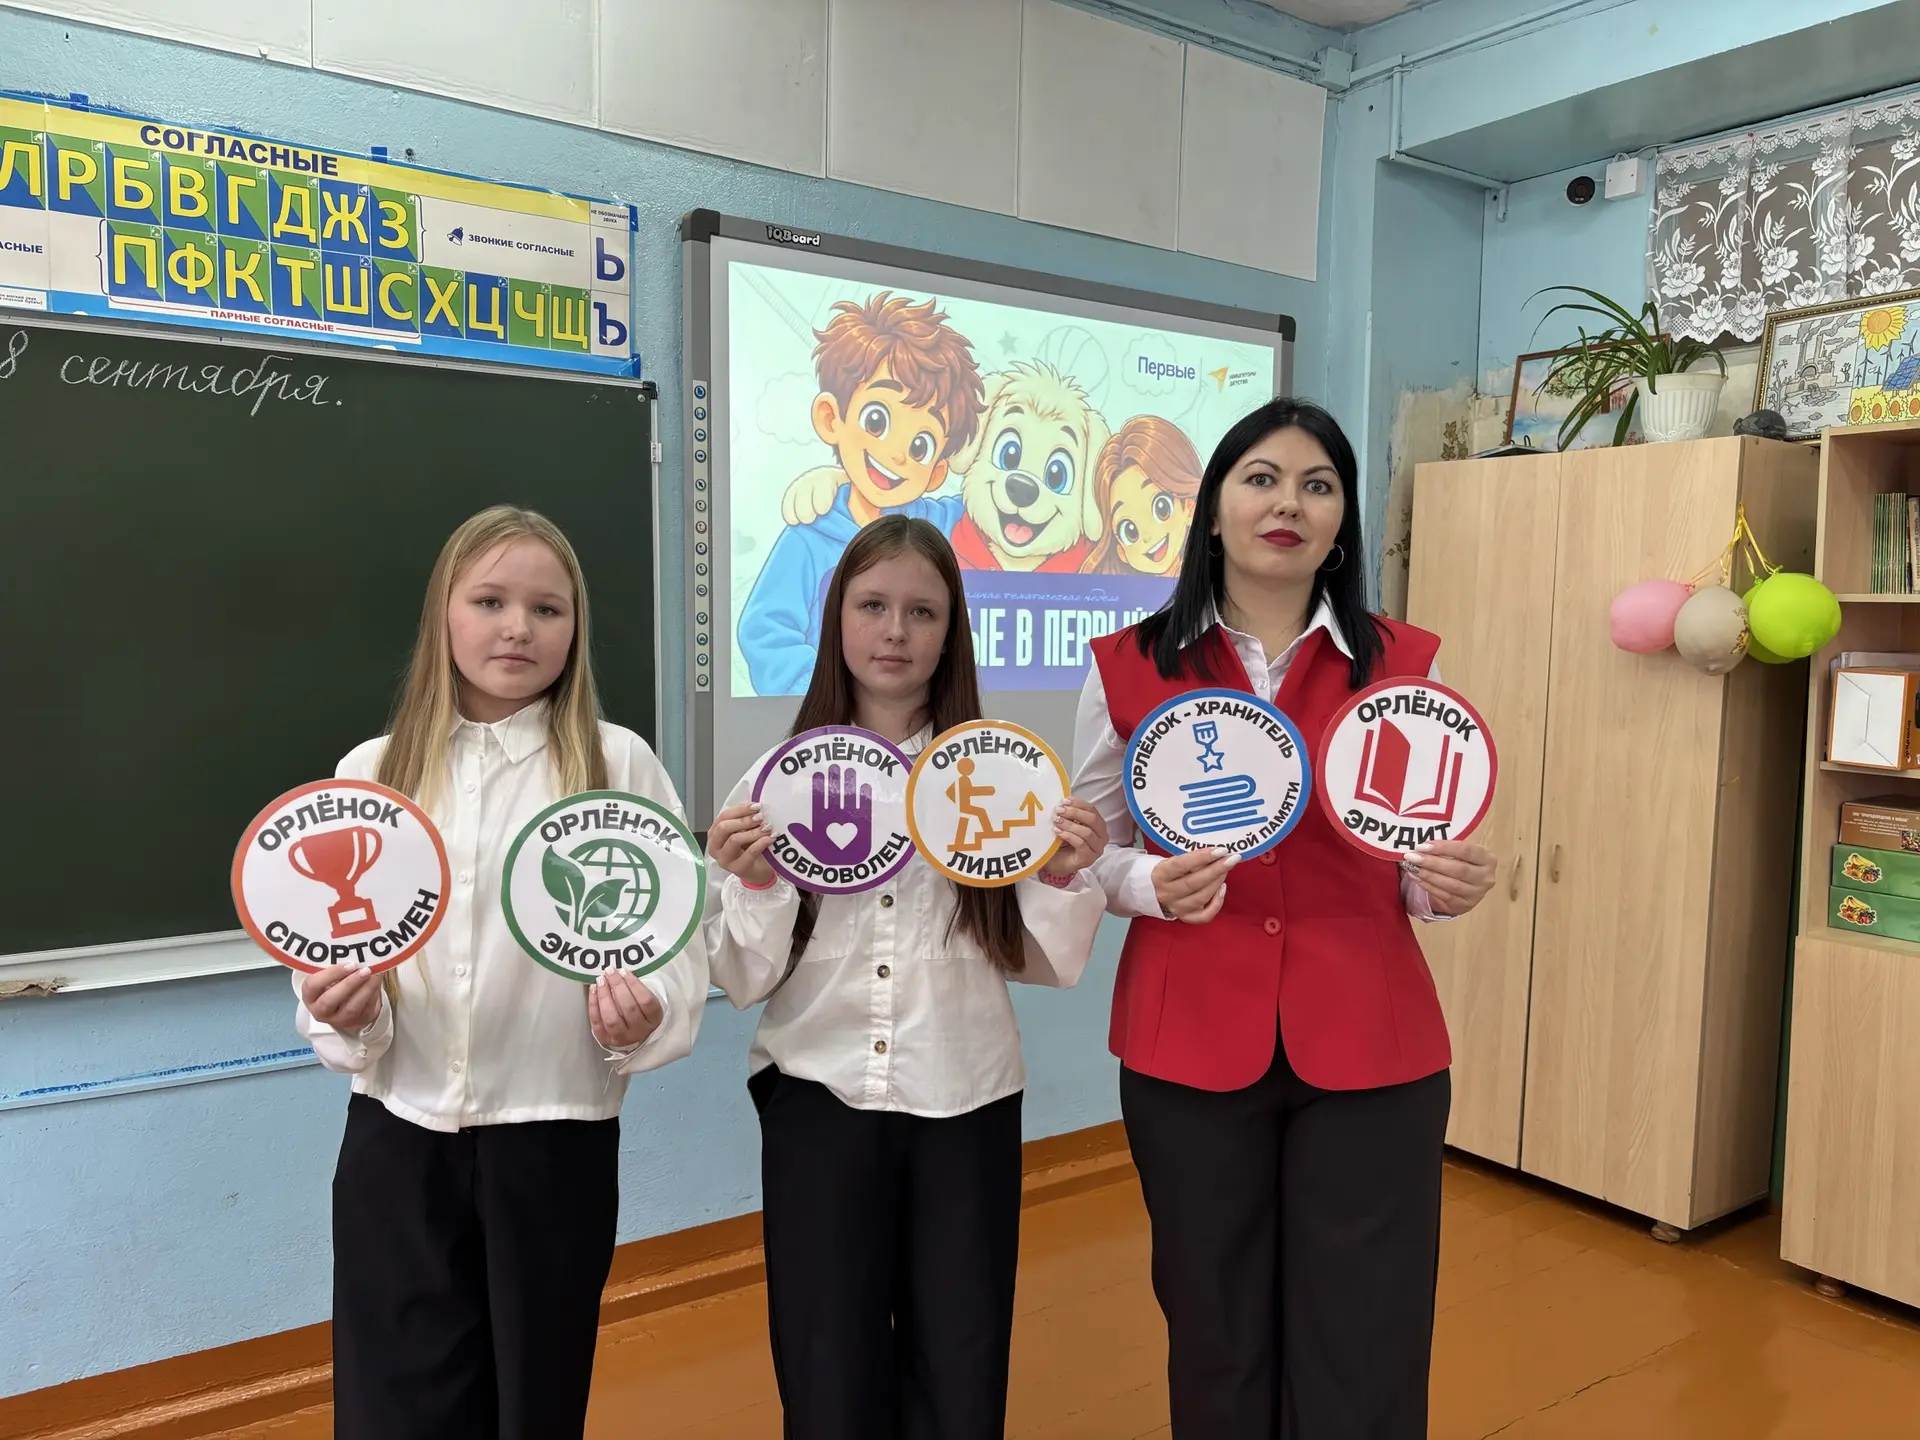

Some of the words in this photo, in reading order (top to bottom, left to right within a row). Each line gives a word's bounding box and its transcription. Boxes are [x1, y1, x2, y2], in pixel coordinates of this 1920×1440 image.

[140, 125, 338, 176] СОГЛАСНЫЕ
[0, 140, 42, 196] Л
[57, 148, 98, 201] Р
[113, 156, 154, 210] Б
[169, 164, 209, 218] В
[227, 174, 257, 225] Г
[272, 183, 318, 244] Д
[322, 190, 369, 245] Ж
[378, 200, 409, 249] З
[468, 234, 514, 249] ЗВОНКИЕ
[516, 240, 575, 258] СОГЛАСНЫЕ
[595, 236, 626, 282] Ь
[113, 234, 158, 289] П
[167, 242, 215, 295] Ф
[225, 249, 266, 302] К
[276, 256, 316, 307] Т
[325, 263, 369, 315] Ш
[378, 272, 413, 321] С
[424, 276, 459, 327] Х
[468, 283, 504, 339] Ц
[514, 290, 545, 338] Ч
[552, 295, 588, 350] Щ
[210, 310, 261, 323] ПАРНЫЕ
[264, 316, 335, 333] СОГЛАСНЫЕ
[593, 301, 628, 347] Ъ
[60, 354, 343, 417] сентября.
[1138, 356, 1196, 381] Первые
[1016, 608, 1033, 667] В
[1357, 689, 1478, 742] ОРЛЁНОК
[780, 737, 900, 778] ОРЛЁНОК
[932, 731, 1045, 769] ОРЛЁНОК
[1133, 711, 1181, 790] ОРЛЁНОК
[1195, 701, 1295, 759] ХРАНИТЕЛЬ
[258, 793, 405, 851] ОРЛЁНОК
[540, 802, 681, 852] ОРЛЁНОК
[1259, 781, 1300, 839] ПАМЯТИ
[1343, 809, 1451, 850] ЭРУДИТ
[772, 832, 910, 884] ДОБРОВОЛЕЦ
[947, 847, 1032, 879] ЛИДЕР
[265, 888, 439, 965] СПОРТСМЕН
[540, 932, 655, 970] ЭКОЛОГ
